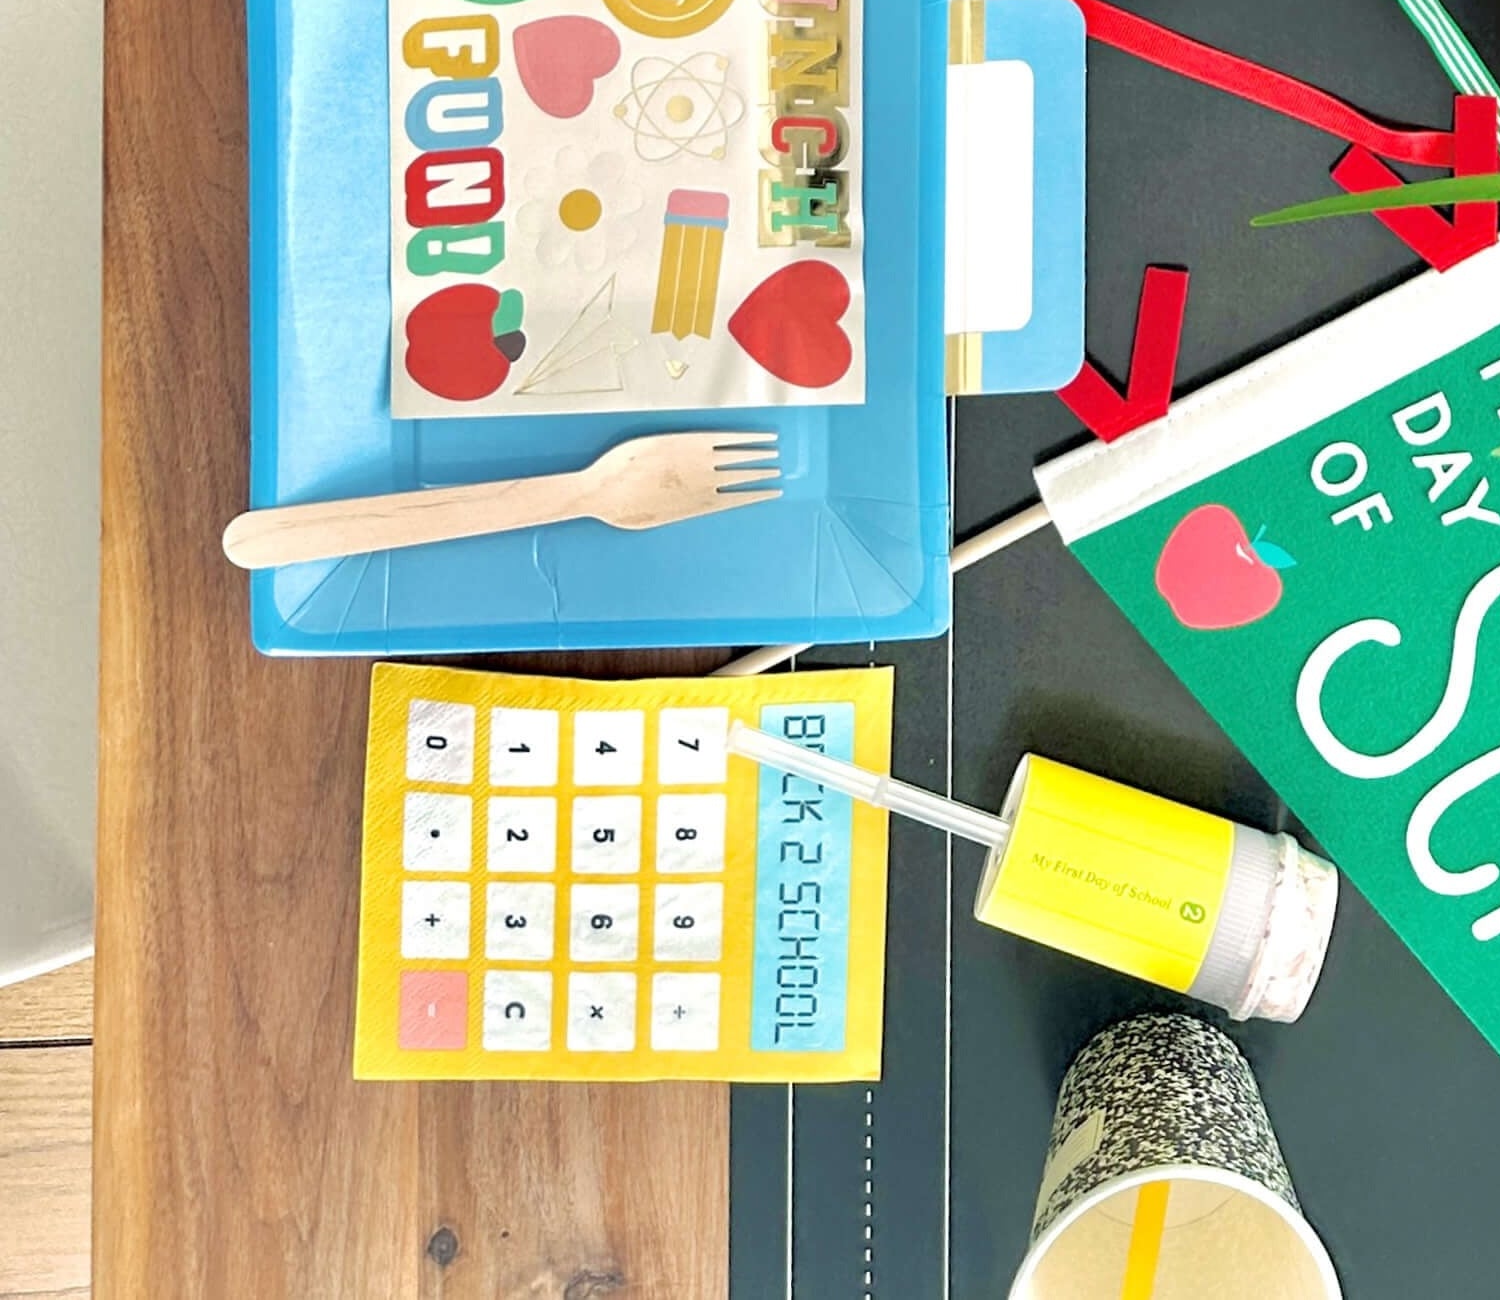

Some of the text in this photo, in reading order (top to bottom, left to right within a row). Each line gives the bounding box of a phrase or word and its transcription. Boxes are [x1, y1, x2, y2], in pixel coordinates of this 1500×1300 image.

[402, 13, 505, 278] FUN!
[1309, 438, 1394, 533] OF
[425, 735, 448, 750] 0
[508, 743, 531, 753] 1
[595, 740, 617, 755] 4
[677, 738, 700, 752] 7
[506, 828, 529, 842] 2
[592, 828, 615, 844] 5
[675, 827, 697, 841] 8
[773, 714, 826, 1046] BCK 2 SCHOOL
[1030, 852, 1053, 874] My
[1055, 857, 1084, 880] First
[1085, 869, 1111, 893] Day
[1112, 878, 1129, 899] of
[1128, 885, 1173, 912] School
[504, 914, 527, 929] 3
[590, 914, 613, 930] 6
[672, 915, 695, 929] 9
[504, 1001, 526, 1019] C
